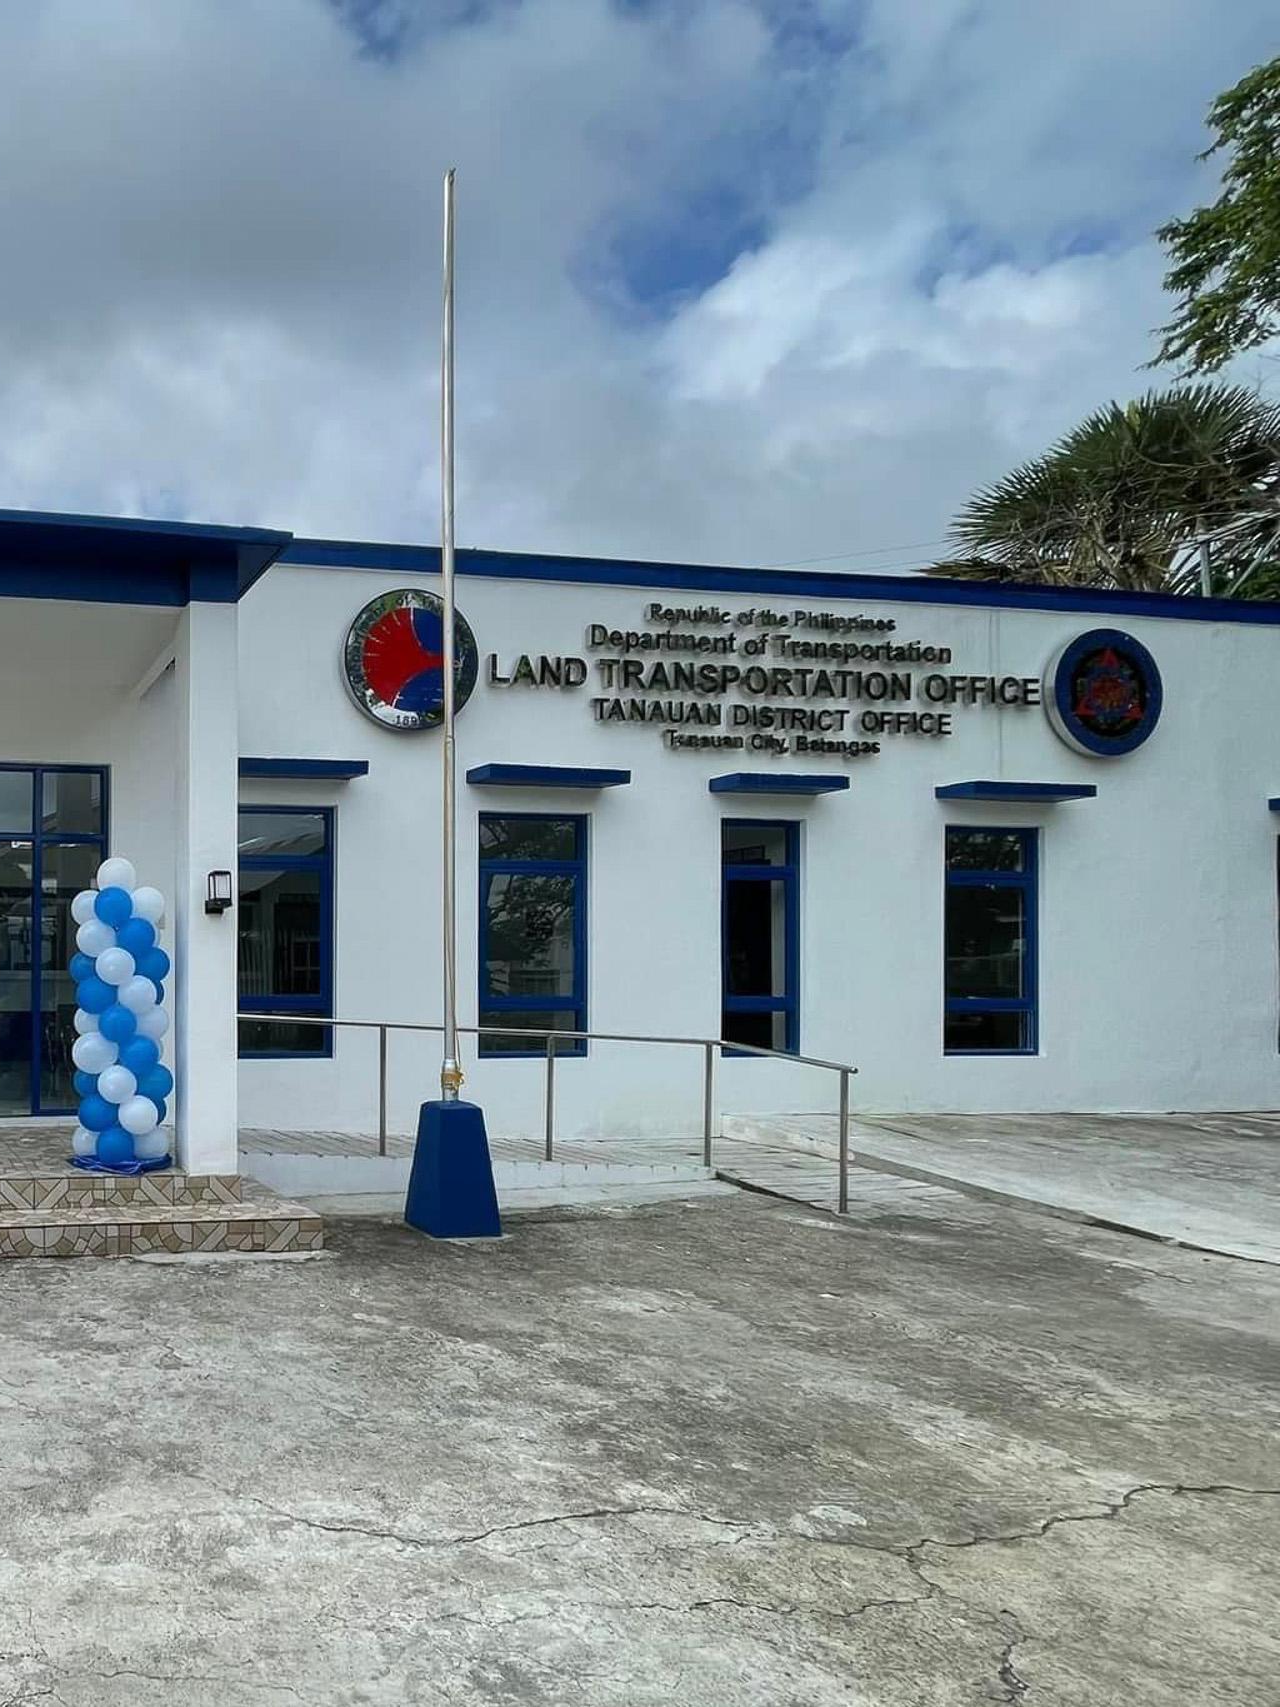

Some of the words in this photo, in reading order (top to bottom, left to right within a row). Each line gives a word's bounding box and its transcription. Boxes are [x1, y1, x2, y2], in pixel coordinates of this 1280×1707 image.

[737, 608, 757, 626] of
[757, 609, 789, 628] the
[792, 610, 897, 634] Philippines
[589, 623, 736, 653] Department
[744, 632, 769, 655] of
[771, 633, 952, 664] Transportation
[488, 653, 588, 687] LAND
[597, 658, 912, 701] TRANSPORTATION
[924, 673, 1041, 706] OFFICE
[591, 697, 721, 725] TANAUAN
[732, 704, 850, 731] DISTRICT
[860, 711, 952, 735] OFFICE
[666, 729, 744, 749] Tanauan
[795, 736, 881, 757] Batangas
